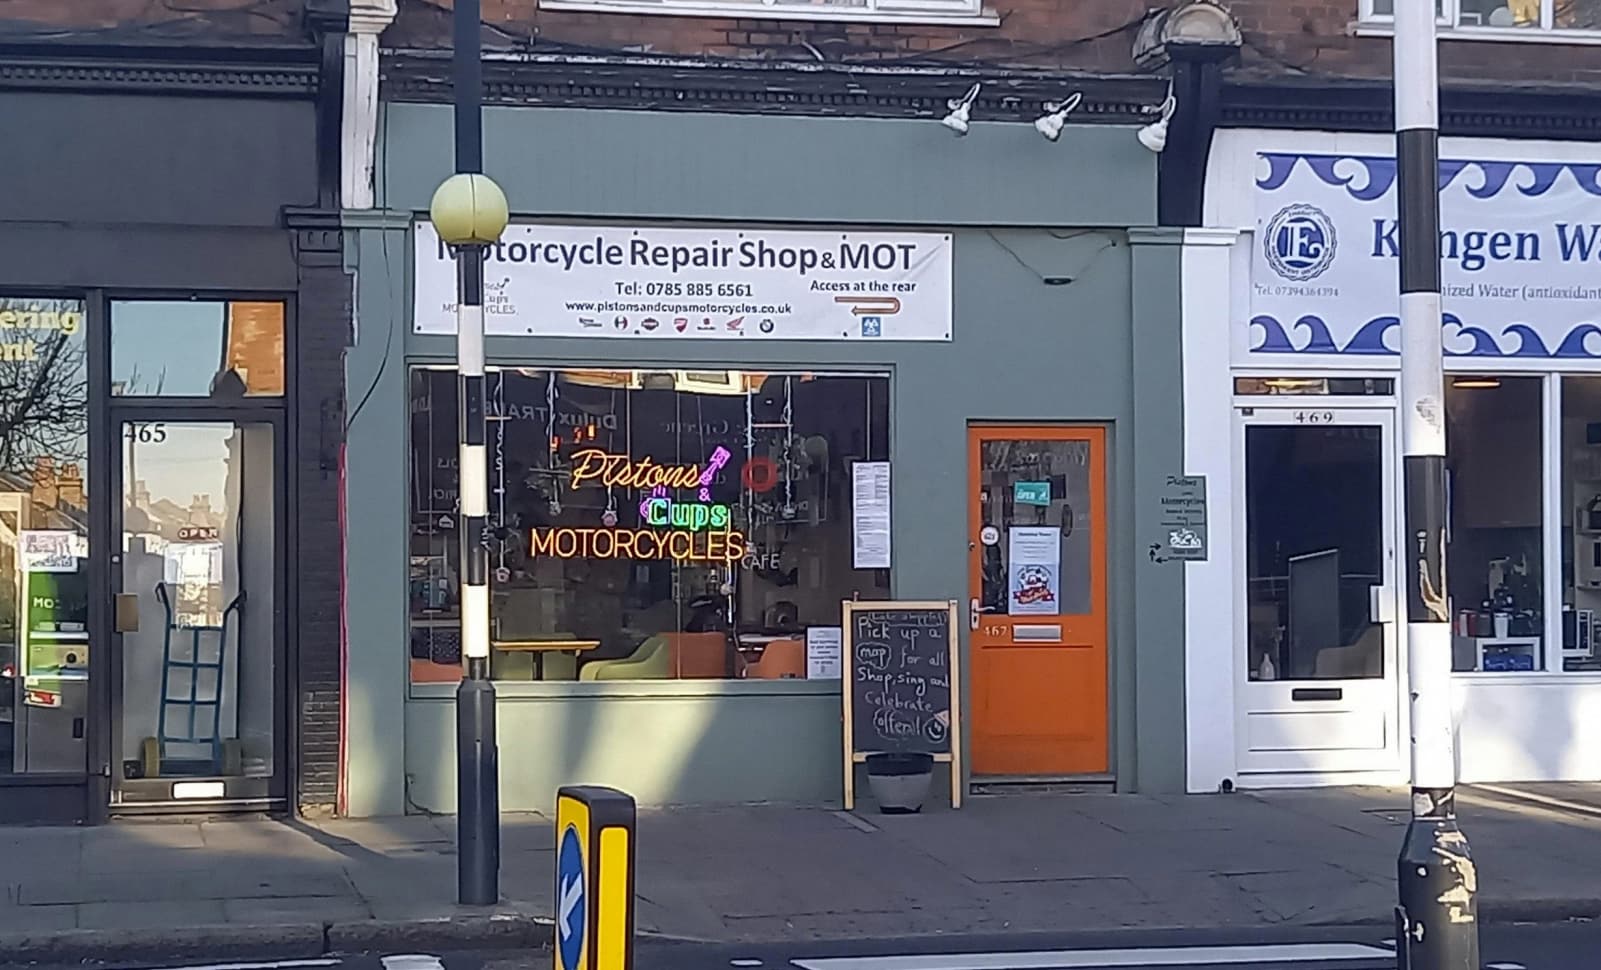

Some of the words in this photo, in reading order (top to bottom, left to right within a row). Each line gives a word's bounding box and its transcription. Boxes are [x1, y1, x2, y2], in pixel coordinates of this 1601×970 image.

[437, 236, 623, 271] torcycle
[630, 239, 734, 273] Repair
[738, 239, 818, 276] Shop
[820, 251, 836, 269] &
[840, 243, 917, 270] MOT
[1371, 219, 1541, 271] Kngen
[1555, 223, 1601, 263] W
[615, 282, 643, 296] Tel:
[646, 282, 683, 297] 0785
[686, 283, 714, 297] 885
[717, 283, 753, 297] 6561
[810, 279, 851, 292] Access
[853, 280, 866, 292] at
[868, 280, 889, 292] the
[891, 282, 917, 292] rear
[1478, 284, 1519, 298] Water
[0, 304, 81, 335] ering
[565, 301, 792, 316] www.pistonsandcupsmotorcycles.co.uk
[1295, 411, 1333, 424] 469
[124, 423, 167, 443] 465
[570, 449, 701, 490] Pistons
[699, 487, 711, 502] &
[648, 499, 729, 531] Cups
[530, 528, 744, 561] MOTORCYCLES
[858, 616, 891, 639] Pick
[900, 628, 920, 651] up
[928, 628, 943, 639] a
[860, 648, 887, 668] map
[900, 645, 920, 669] for
[928, 651, 945, 667] all
